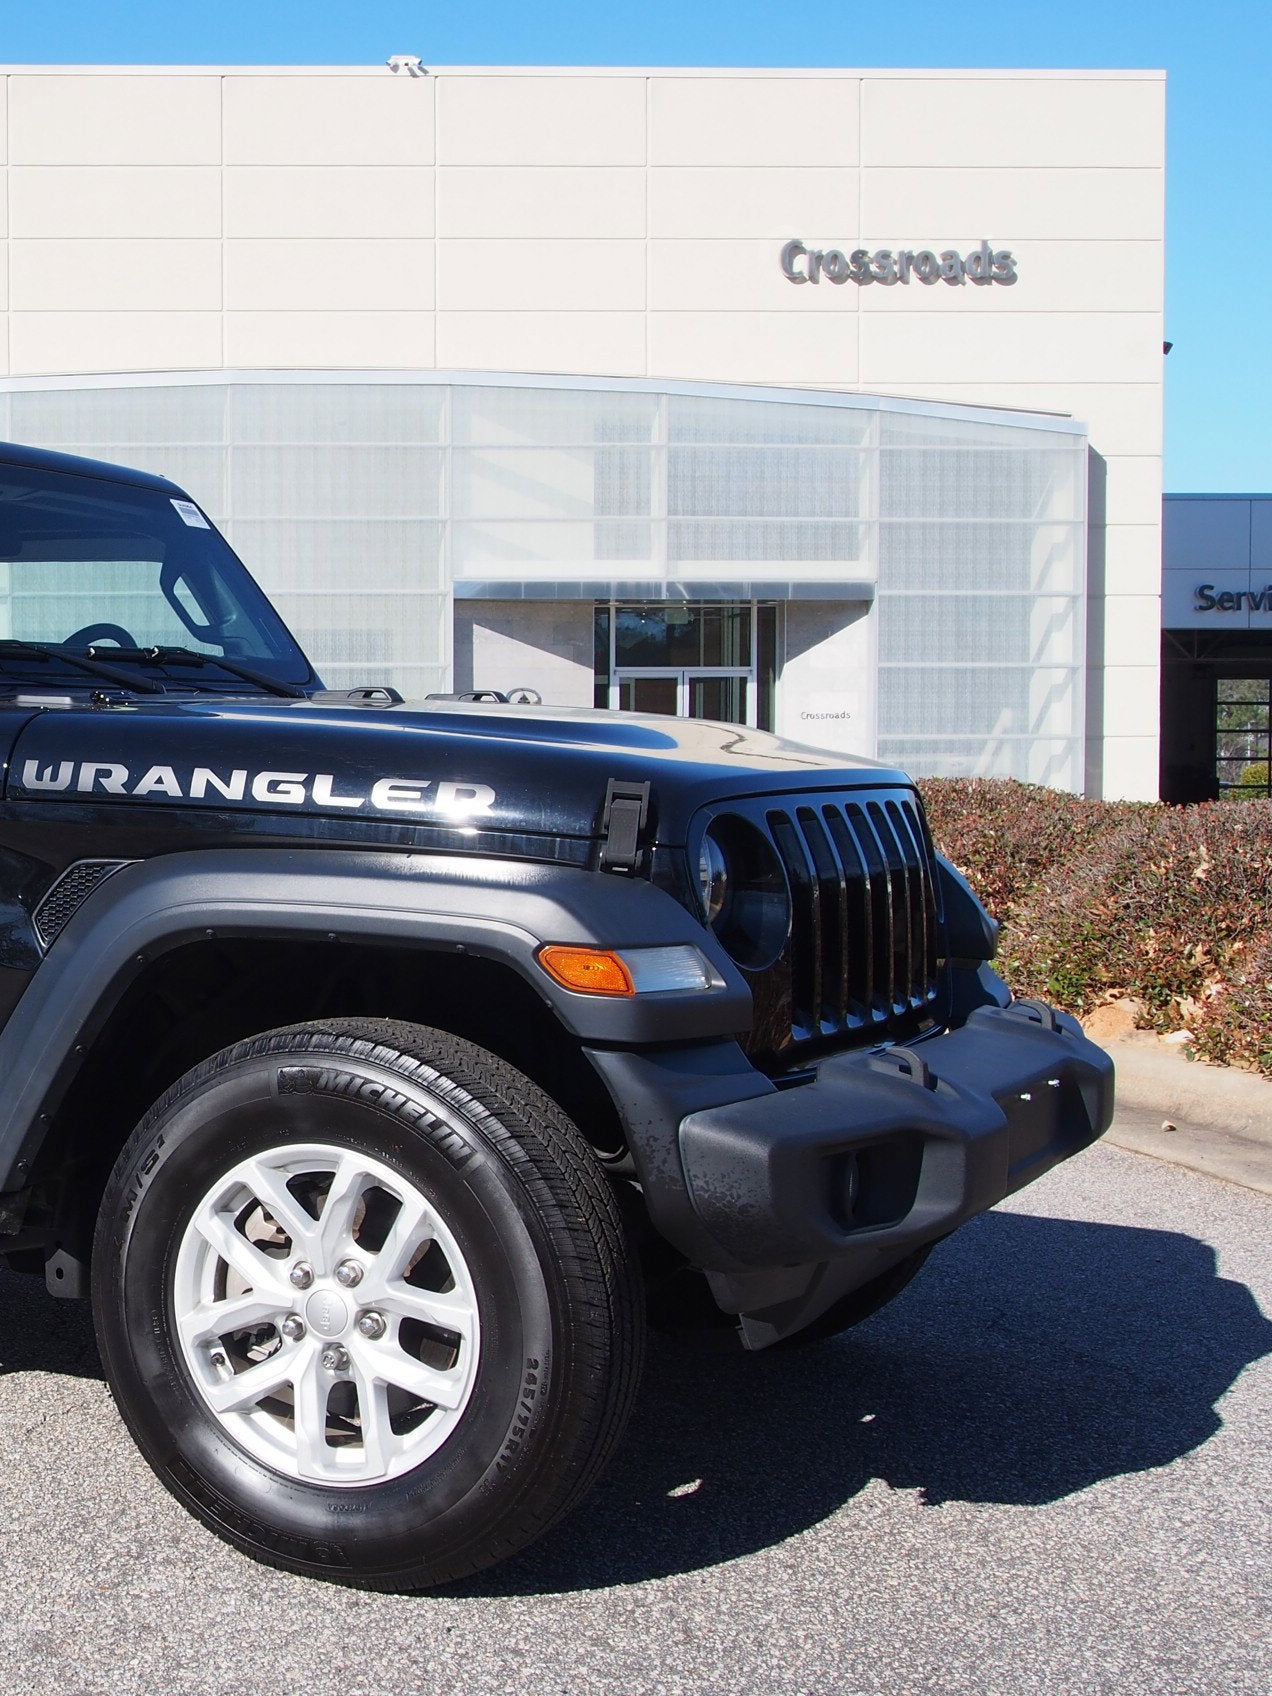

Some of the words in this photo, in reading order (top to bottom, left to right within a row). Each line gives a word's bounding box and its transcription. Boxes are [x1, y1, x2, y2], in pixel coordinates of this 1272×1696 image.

[780, 239, 1017, 284] Crossroads
[1194, 584, 1272, 611] Servi
[800, 710, 851, 720] Crossroads
[22, 758, 496, 817] WRANGLER
[316, 1070, 473, 1160] MICHELIN
[495, 1357, 540, 1474] 245/75R17
